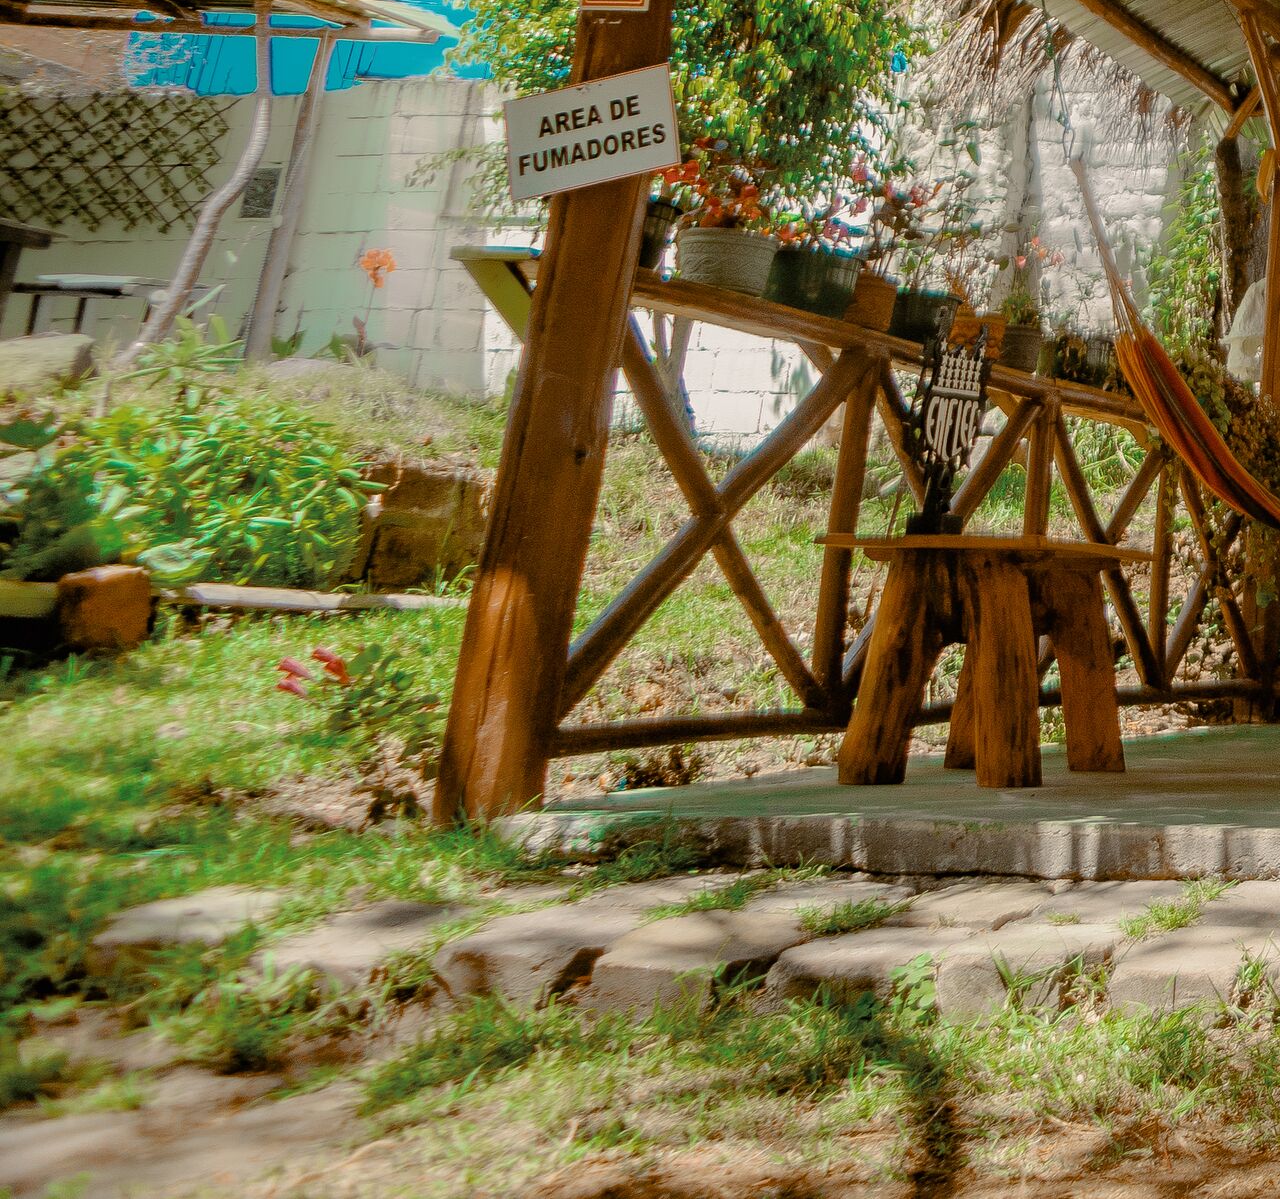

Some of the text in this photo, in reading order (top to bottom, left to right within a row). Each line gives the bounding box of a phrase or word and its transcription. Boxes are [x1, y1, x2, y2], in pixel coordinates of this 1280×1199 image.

[539, 95, 641, 138] AREA DE
[519, 123, 666, 176] FUMADORES
